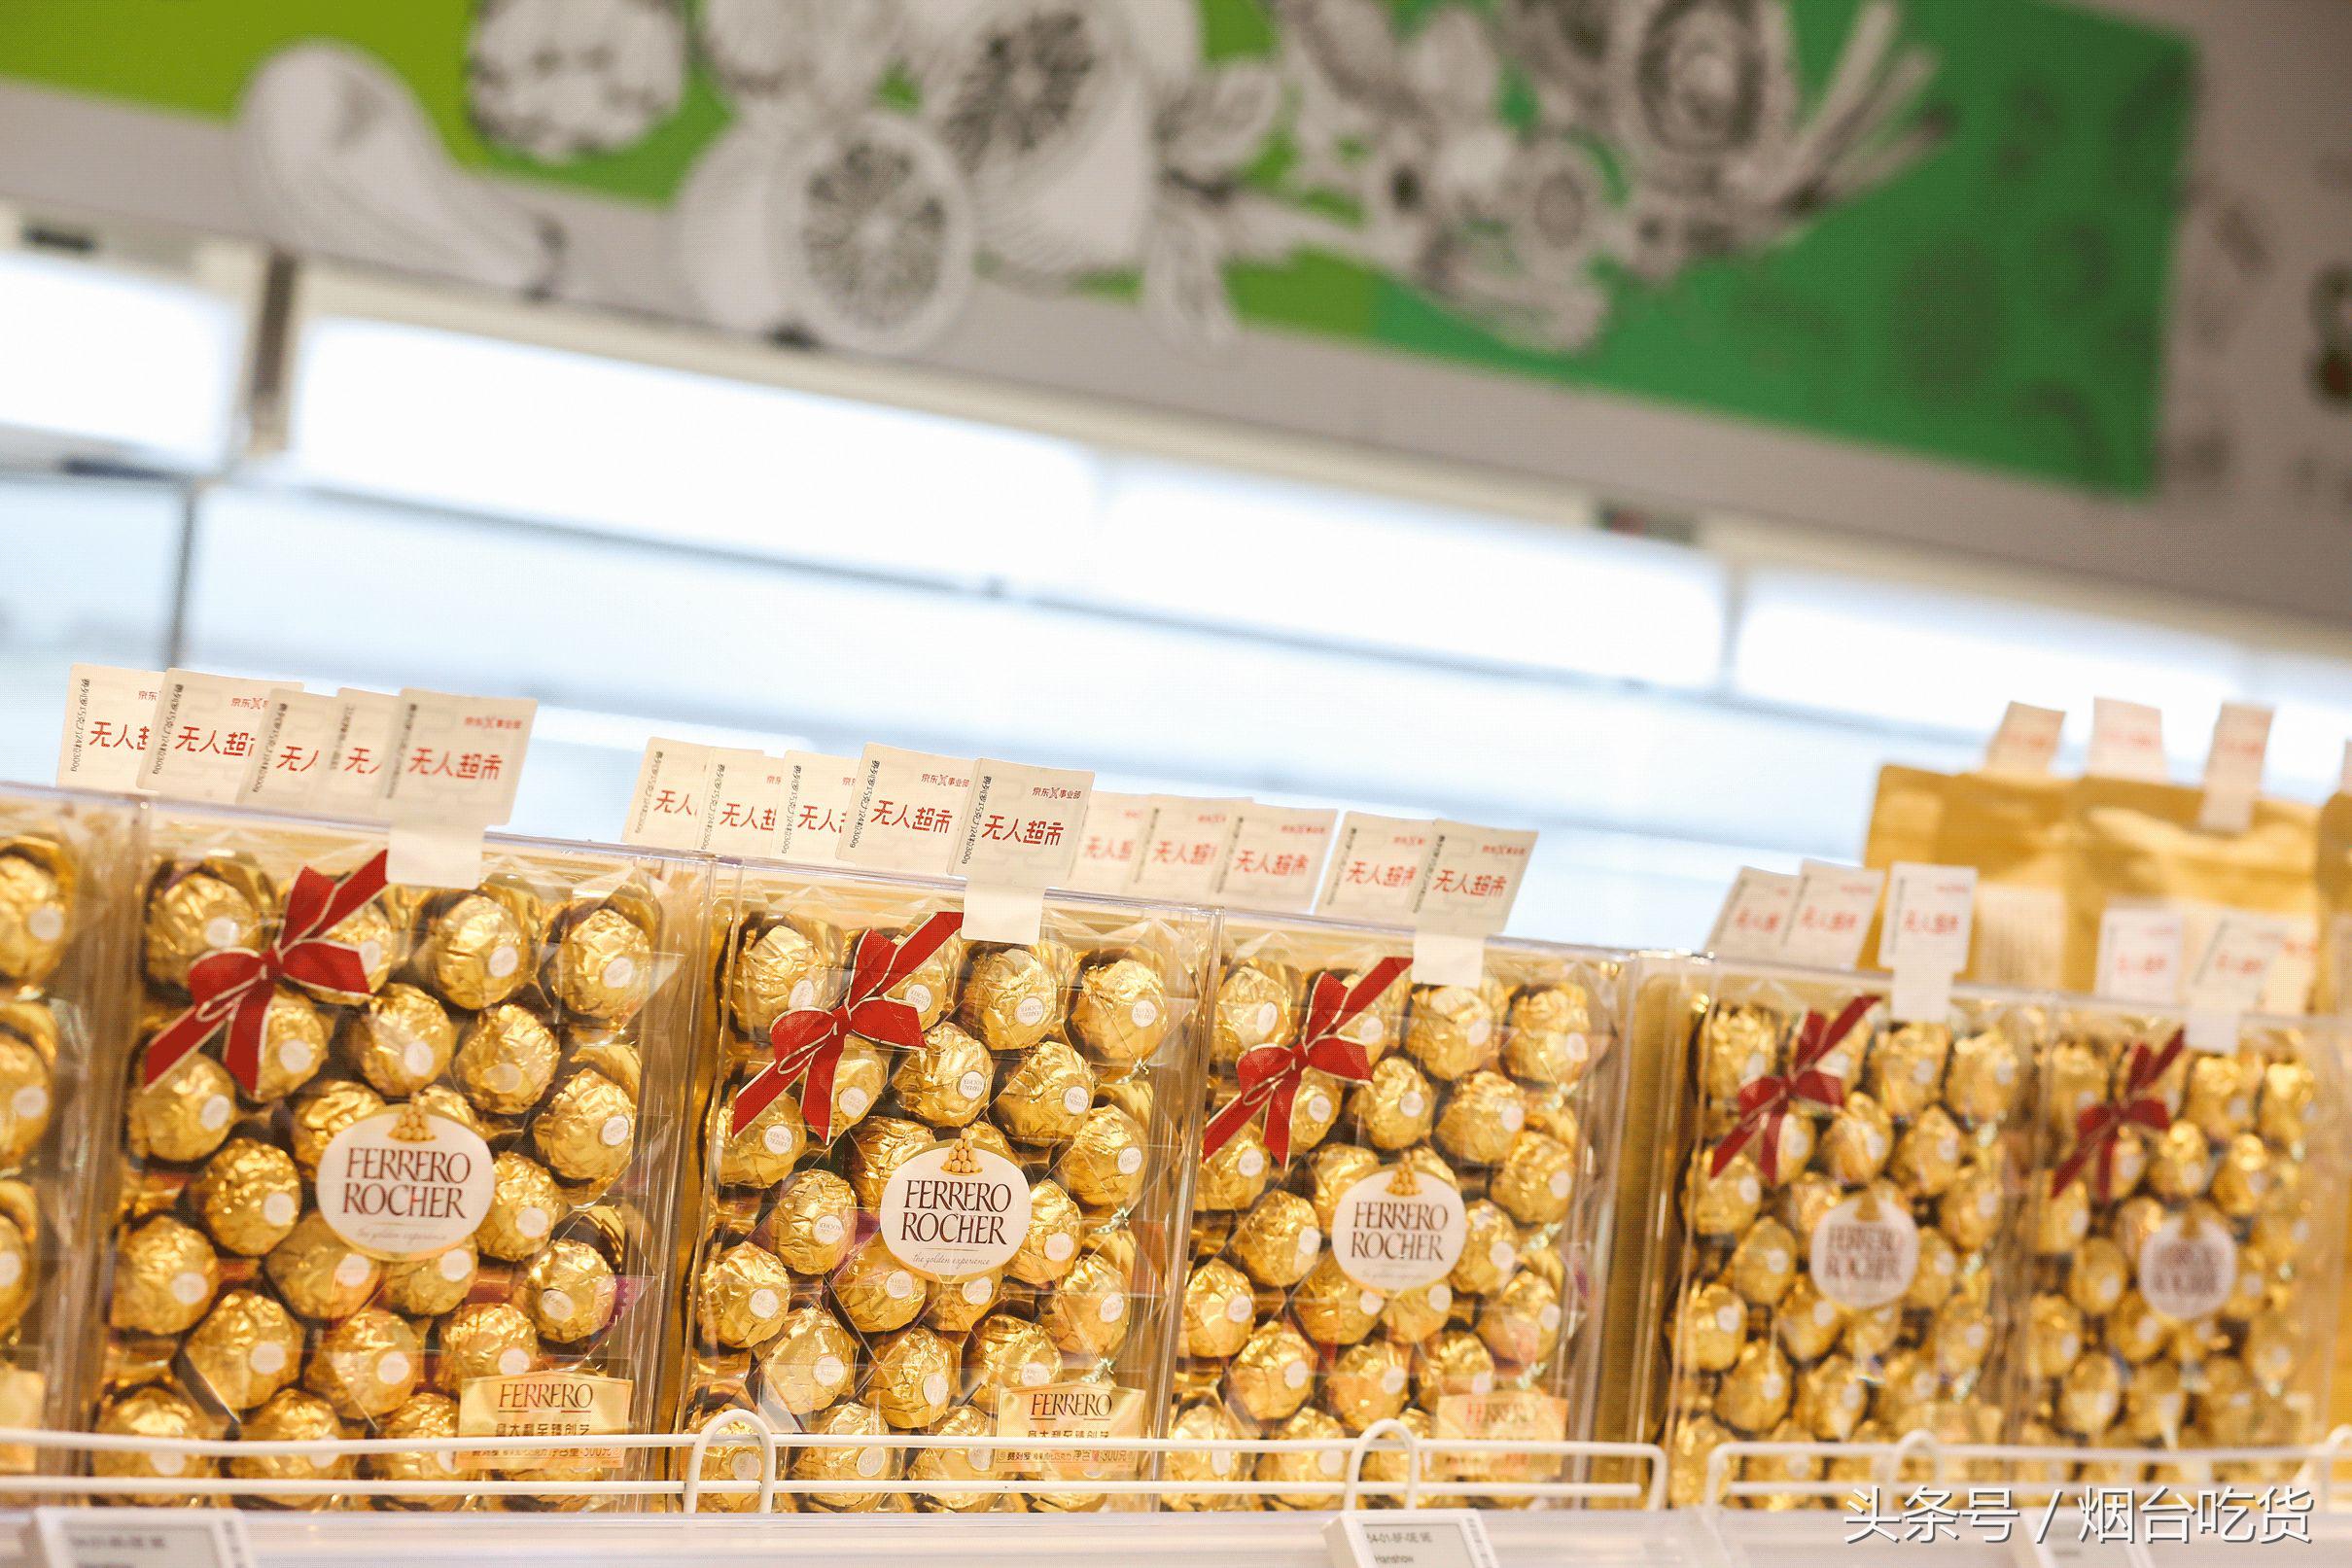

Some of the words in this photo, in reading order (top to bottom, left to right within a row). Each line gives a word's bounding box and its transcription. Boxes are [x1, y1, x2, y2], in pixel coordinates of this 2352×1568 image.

[408, 748, 504, 780] 无人超市
[653, 789, 698, 817] 无人
[870, 799, 953, 834] 无人超市
[797, 805, 848, 834] 无人
[981, 815, 1064, 846] 无人超市
[1234, 850, 1310, 876] 无人超市
[1433, 869, 1507, 897] 无人超市
[346, 1147, 472, 1184] FERRERO
[342, 1182, 467, 1219] ROCHER
[903, 1179, 1012, 1213] FERRERO
[900, 1211, 1008, 1245] ROCHER
[1353, 1202, 1449, 1232] FERRERO
[913, 1252, 925, 1264] the
[925, 1253, 951, 1270] golden
[952, 1257, 990, 1270] experience
[1352, 1231, 1444, 1261] ROCHER
[498, 1383, 594, 1409] FERRERO
[1031, 1393, 1112, 1416] FERRERO
